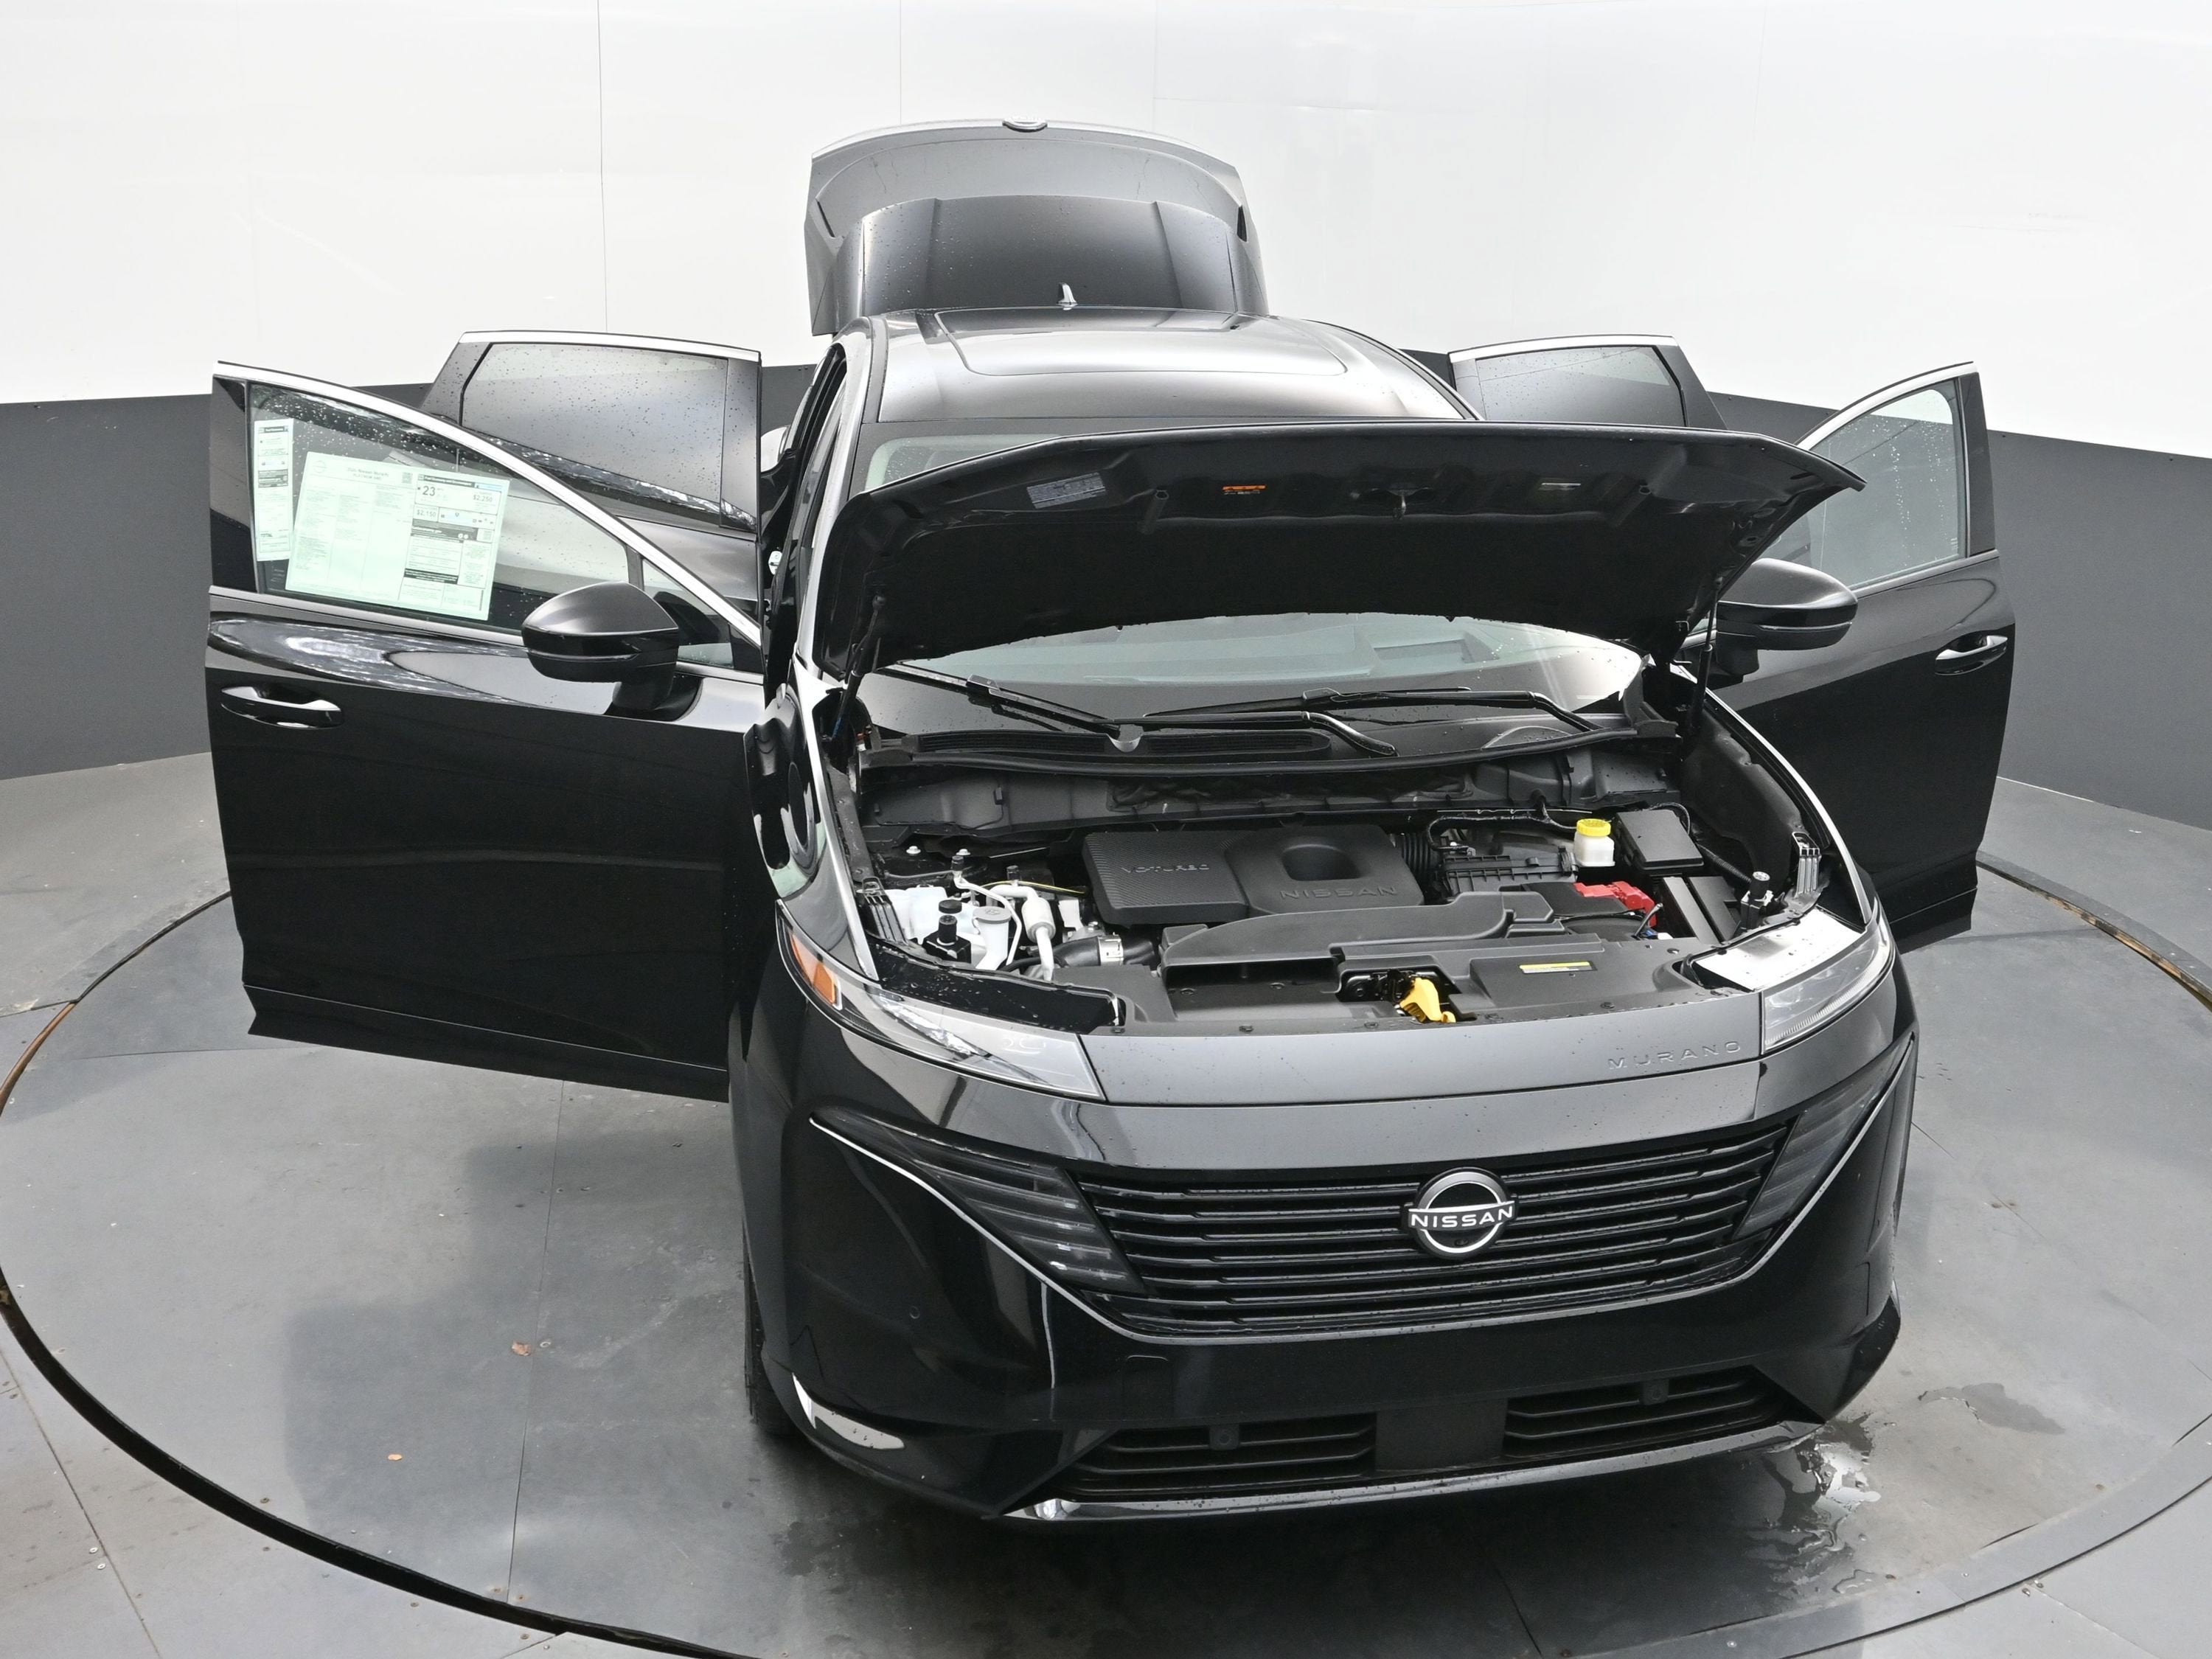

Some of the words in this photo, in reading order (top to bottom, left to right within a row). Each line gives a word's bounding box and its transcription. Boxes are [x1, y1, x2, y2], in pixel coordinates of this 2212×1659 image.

[422, 485, 436, 496] 23
[1280, 886, 1398, 900] NISSAN
[1607, 1040, 1741, 1070] MURANO
[1411, 1206, 1513, 1228] NISSAN
